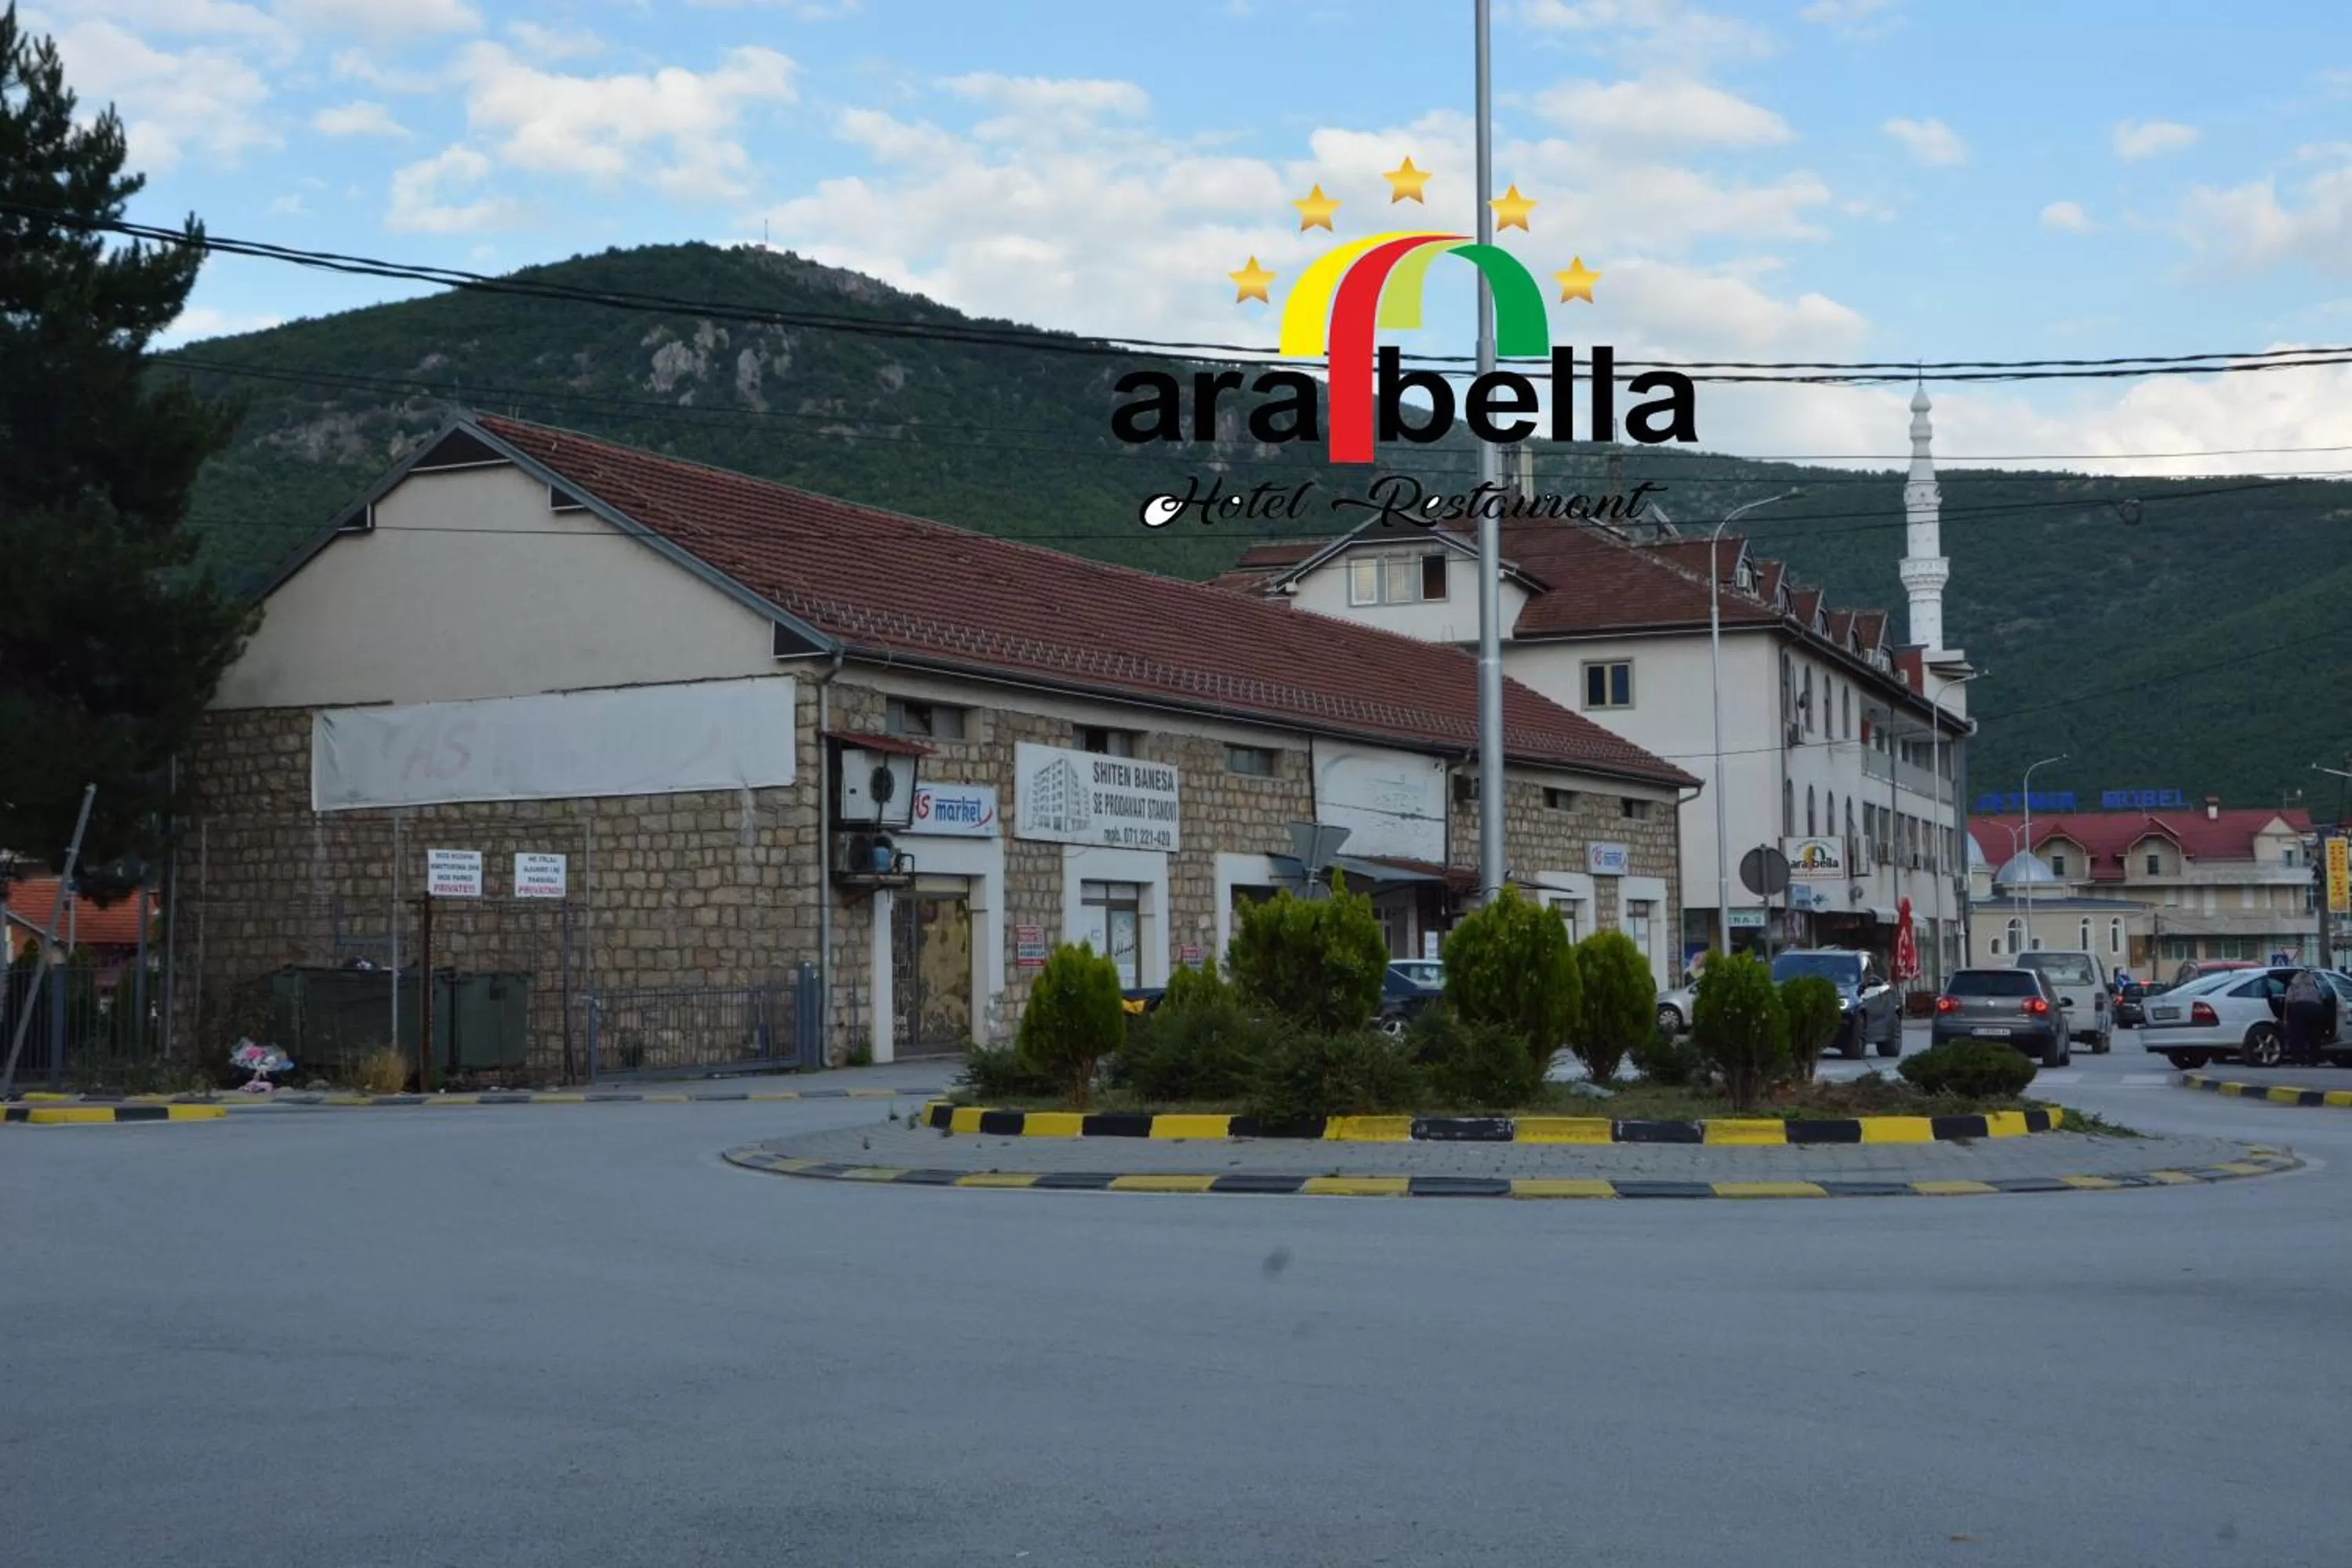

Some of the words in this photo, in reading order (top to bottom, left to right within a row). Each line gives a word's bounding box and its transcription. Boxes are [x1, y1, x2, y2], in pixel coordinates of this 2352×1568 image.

[1093, 761, 1131, 788] SHITEN
[1134, 766, 1174, 793] BANESA
[935, 796, 982, 822] market
[1093, 791, 1102, 815] SE
